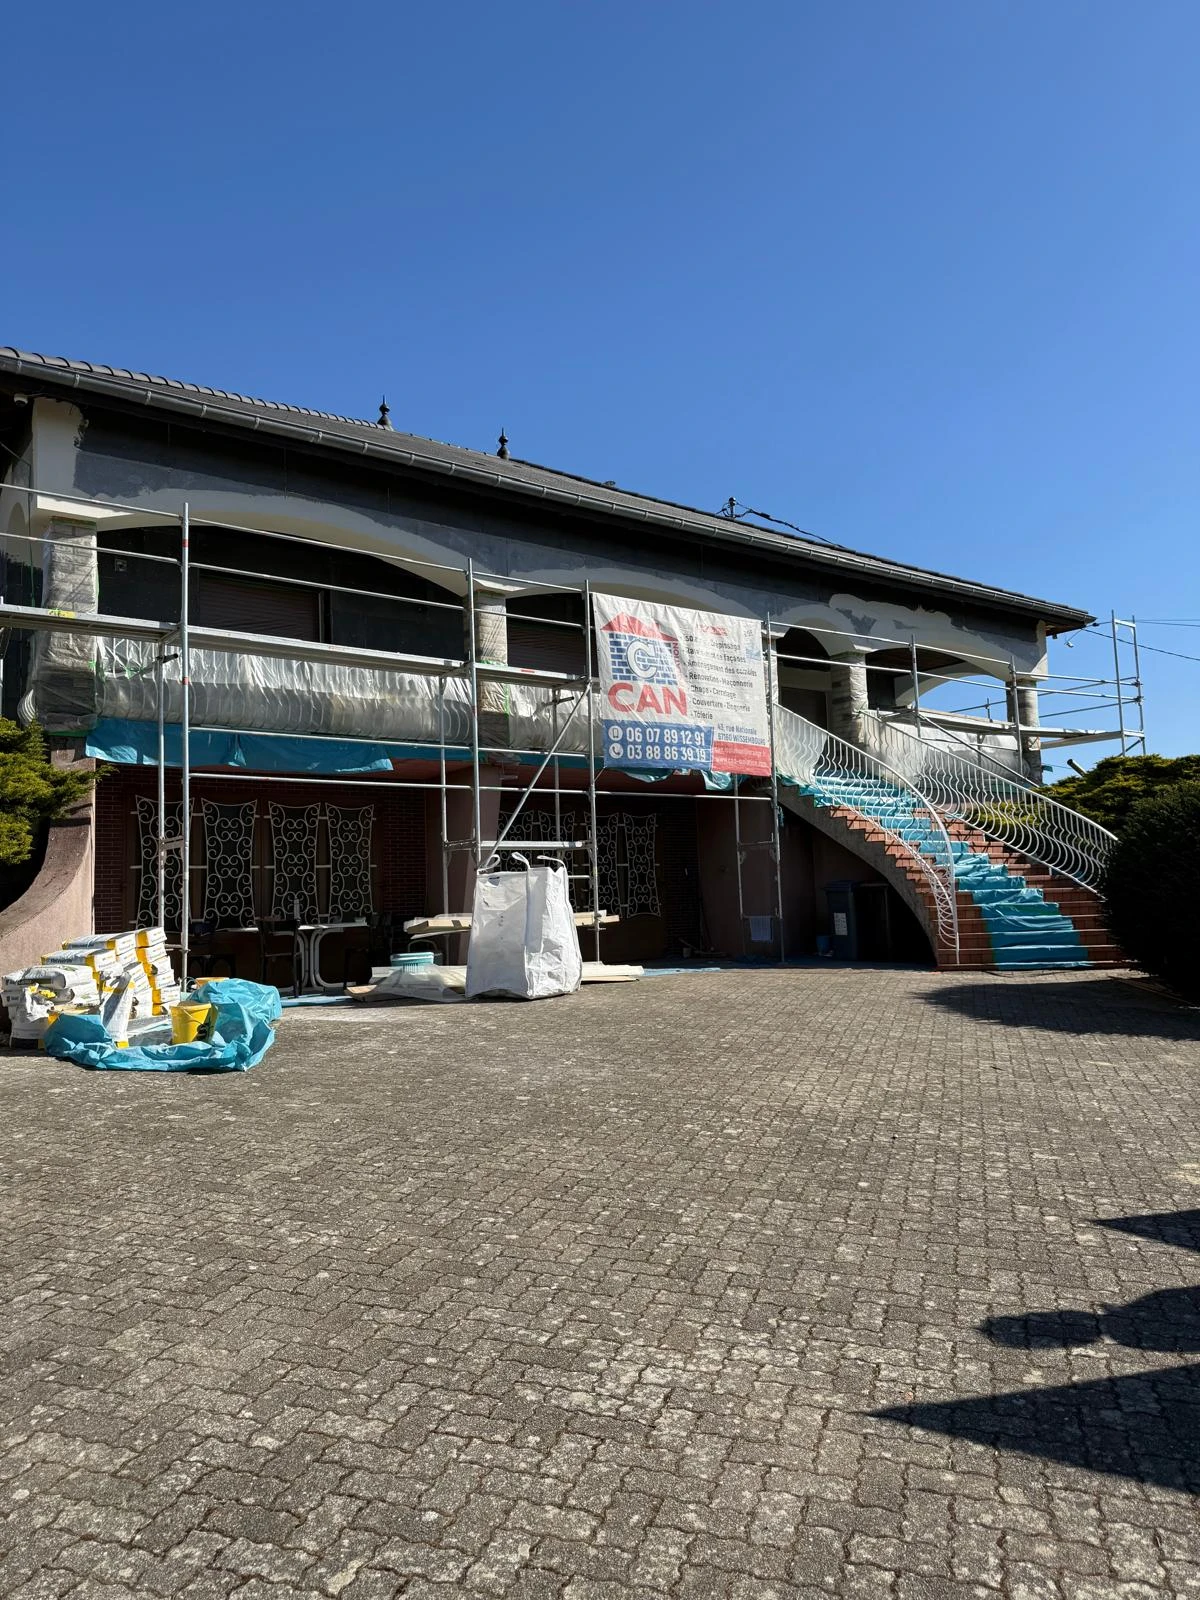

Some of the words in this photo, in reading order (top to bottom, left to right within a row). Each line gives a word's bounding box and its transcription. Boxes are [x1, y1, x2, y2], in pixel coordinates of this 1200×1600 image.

[725, 666, 735, 674] des
[608, 682, 688, 717] CAN
[692, 697, 723, 708] Couverture
[626, 727, 642, 742] 06
[646, 728, 660, 742] 07
[663, 729, 678, 744] 89
[680, 730, 692, 745] 12
[694, 731, 705, 746] 91
[627, 745, 642, 760] 03
[646, 745, 660, 760] 88
[664, 746, 679, 760] 86
[681, 746, 693, 761] 39
[695, 749, 706, 761] 19
